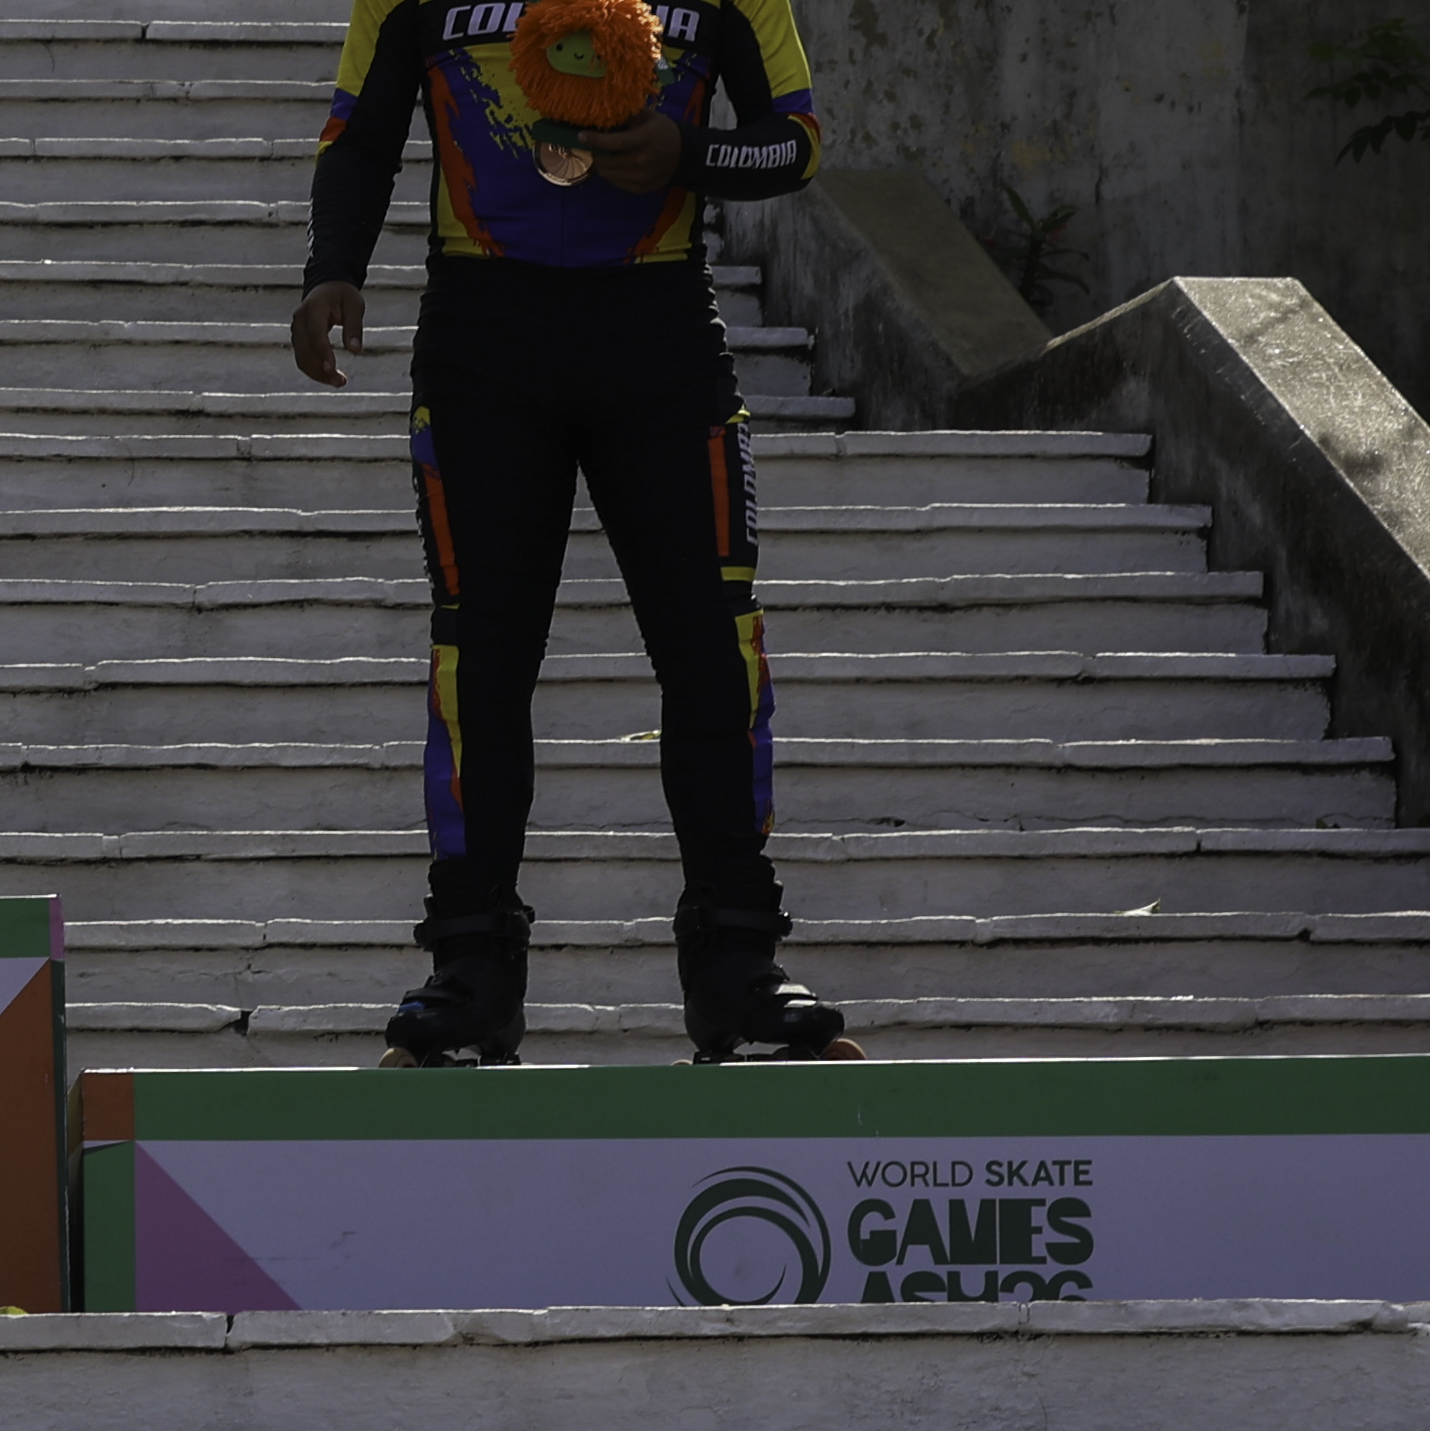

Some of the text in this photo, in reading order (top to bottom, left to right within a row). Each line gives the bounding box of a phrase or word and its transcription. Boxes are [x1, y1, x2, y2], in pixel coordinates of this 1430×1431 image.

[442, 2, 701, 43] COLIA
[705, 139, 797, 170] COLOMBIA
[847, 1160, 1094, 1188] WORLD SKATE
[847, 1197, 1094, 1267] GAMES
